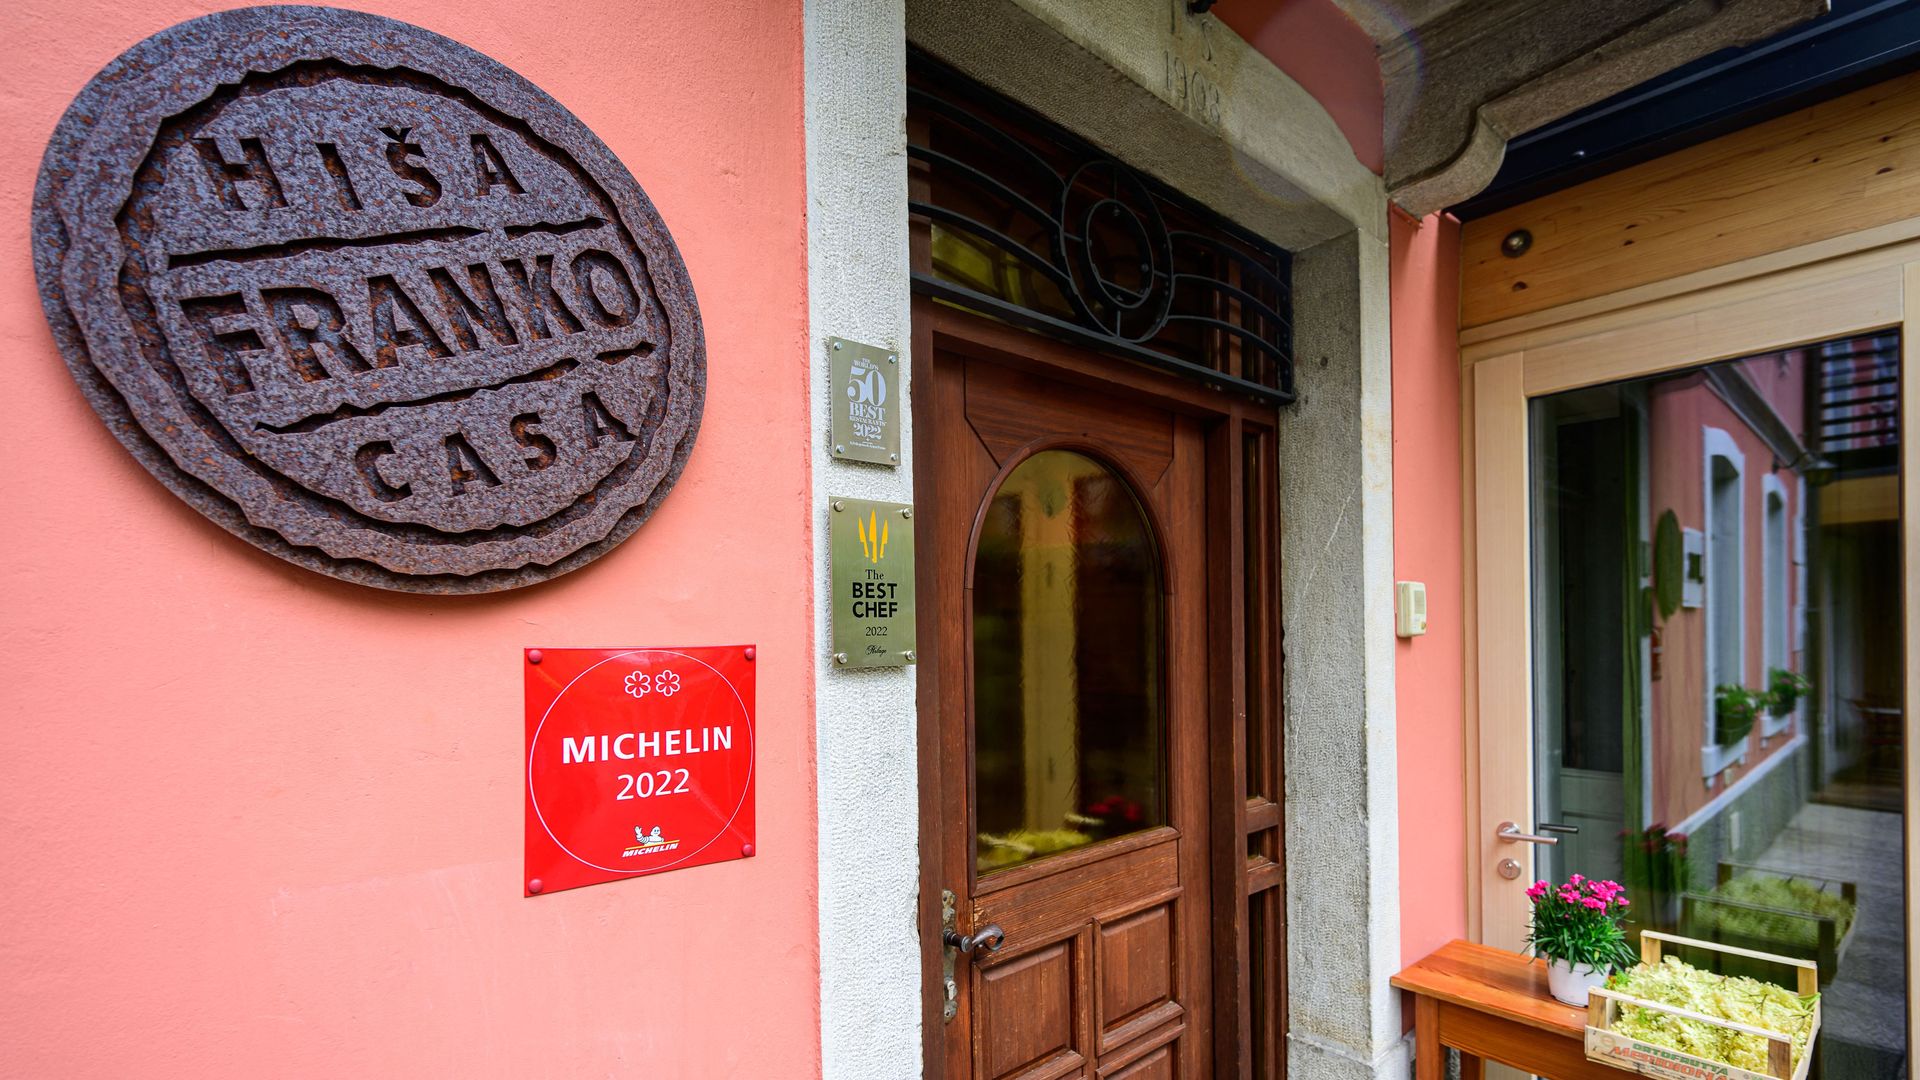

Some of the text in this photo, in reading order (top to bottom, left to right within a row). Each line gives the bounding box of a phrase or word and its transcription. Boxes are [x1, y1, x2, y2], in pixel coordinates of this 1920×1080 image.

[196, 127, 527, 212] HIŠA
[180, 248, 645, 396] FRANKO
[847, 365, 887, 407] 50
[849, 401, 886, 421] BEST
[853, 421, 882, 440] 2022
[354, 390, 636, 503] CASA
[865, 569, 884, 580] The
[852, 582, 897, 599] BEST
[852, 601, 898, 618] CHEF
[865, 626, 888, 636] 2022
[562, 725, 732, 764] MICHELIN
[616, 768, 690, 800] 2022
[622, 843, 679, 858] MICHELIN
